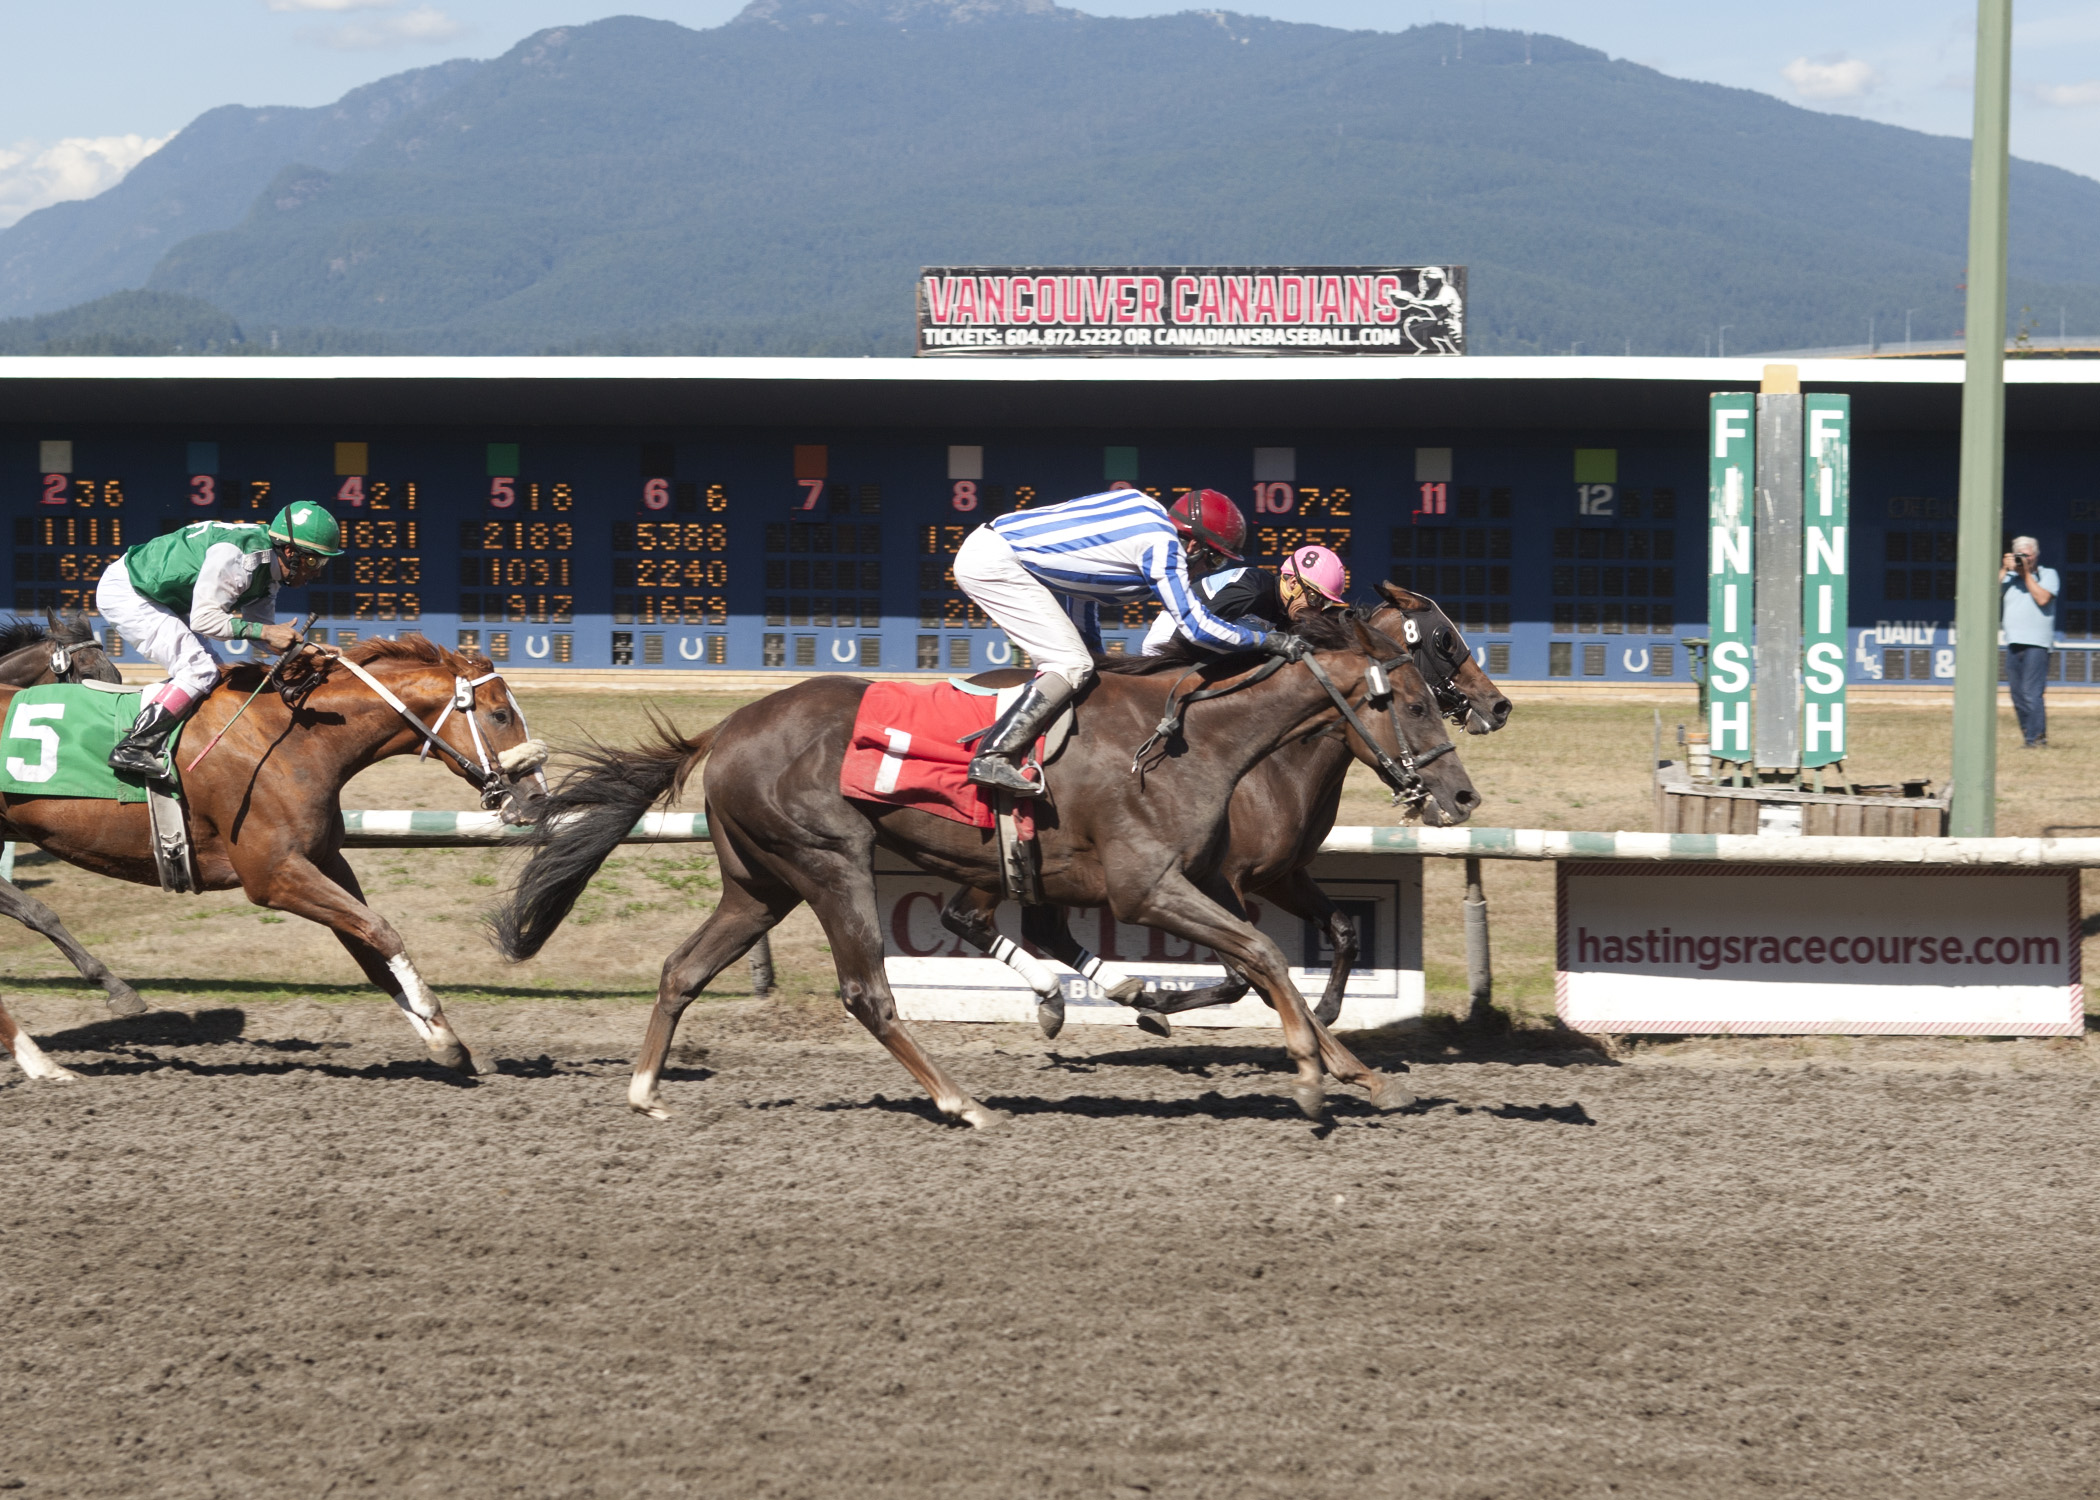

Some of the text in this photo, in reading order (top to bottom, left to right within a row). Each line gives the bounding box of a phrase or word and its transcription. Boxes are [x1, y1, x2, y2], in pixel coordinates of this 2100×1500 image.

[924, 276, 1402, 325] VANCOUVER CANADIANS
[922, 328, 1401, 345] TICKETS: 604.872.5232 OR CANADIANSBASEBALL.COM
[41, 474, 68, 504] 2
[190, 475, 216, 506] 3
[337, 476, 366, 507] 4
[490, 477, 515, 508] 5
[643, 478, 670, 510] 6
[797, 479, 824, 510] 7
[952, 480, 978, 512] 8
[1252, 482, 1294, 514] 10
[1420, 482, 1446, 514] 11
[1577, 484, 1614, 515] 12
[45, 518, 120, 545] 1111
[484, 522, 573, 550] 2189
[637, 523, 727, 551] 5388
[637, 559, 727, 587] 2240
[1302, 551, 1320, 569] 8
[1710, 409, 1750, 751] FINISH
[1804, 410, 1845, 752] FINISH
[1403, 619, 1419, 643] 8
[1873, 620, 1939, 645] DAILY
[455, 681, 471, 708] 5
[1370, 665, 1385, 694] 1
[5, 703, 66, 783] 5
[874, 727, 912, 794] 1
[1578, 927, 2061, 970] hastingsracecourse.com
